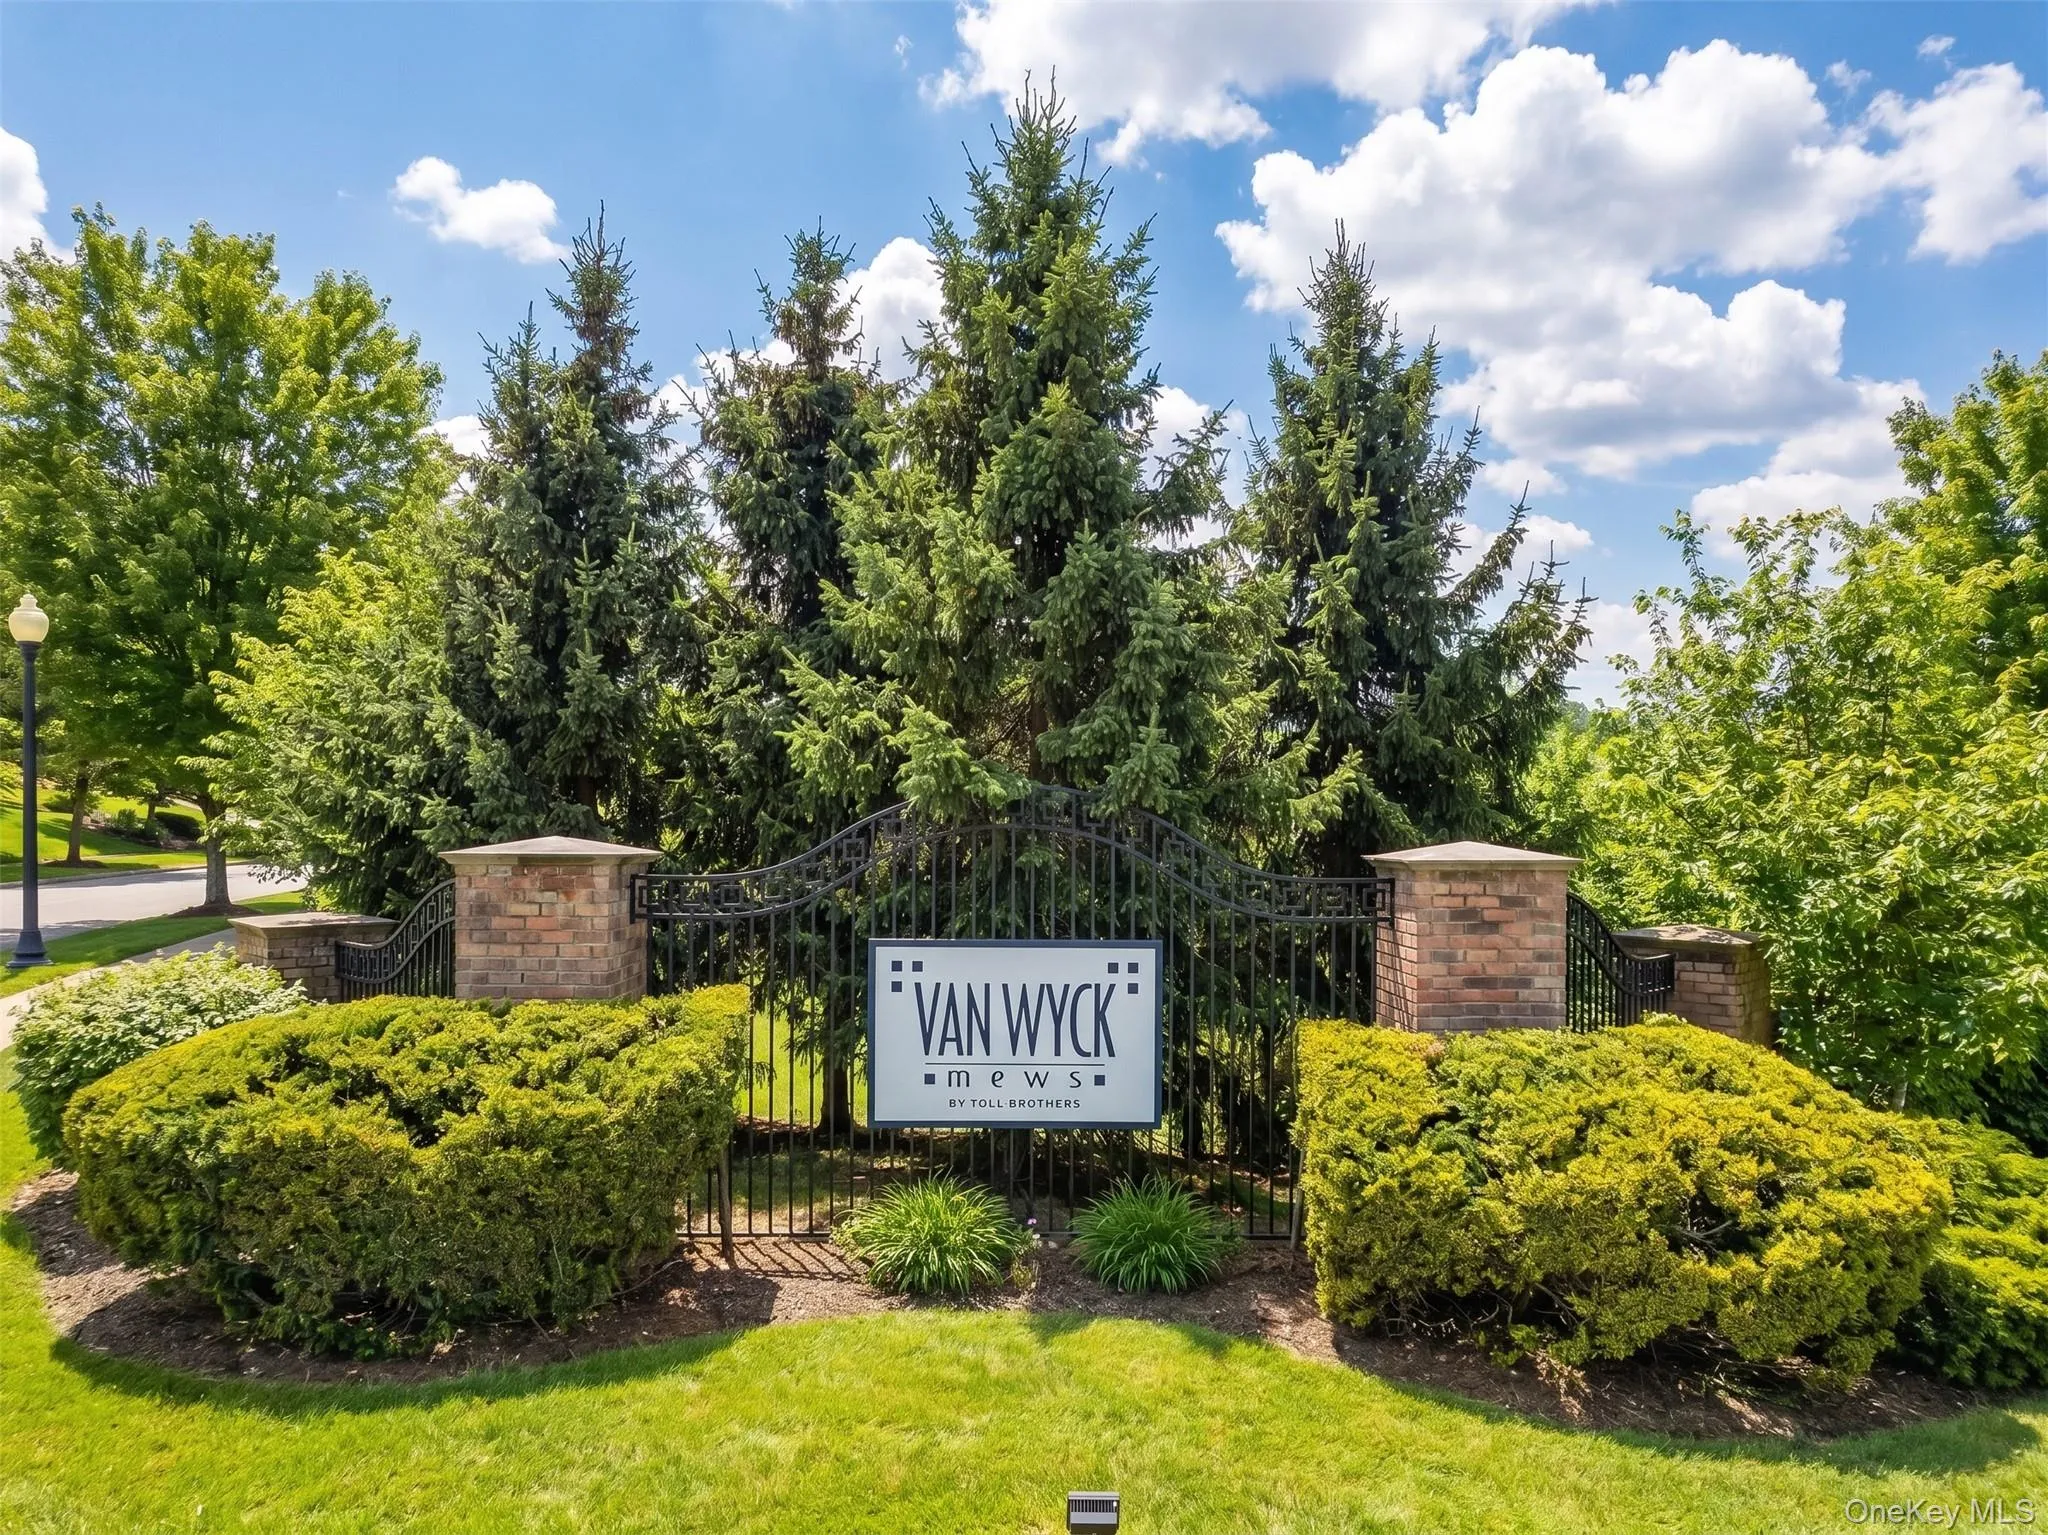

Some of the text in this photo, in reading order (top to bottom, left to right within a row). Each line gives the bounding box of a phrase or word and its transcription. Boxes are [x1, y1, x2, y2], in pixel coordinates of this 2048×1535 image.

[914, 982, 1117, 1058] VAN WYCK
[947, 1070, 1083, 1089] mews
[948, 1098, 966, 1109] BY
